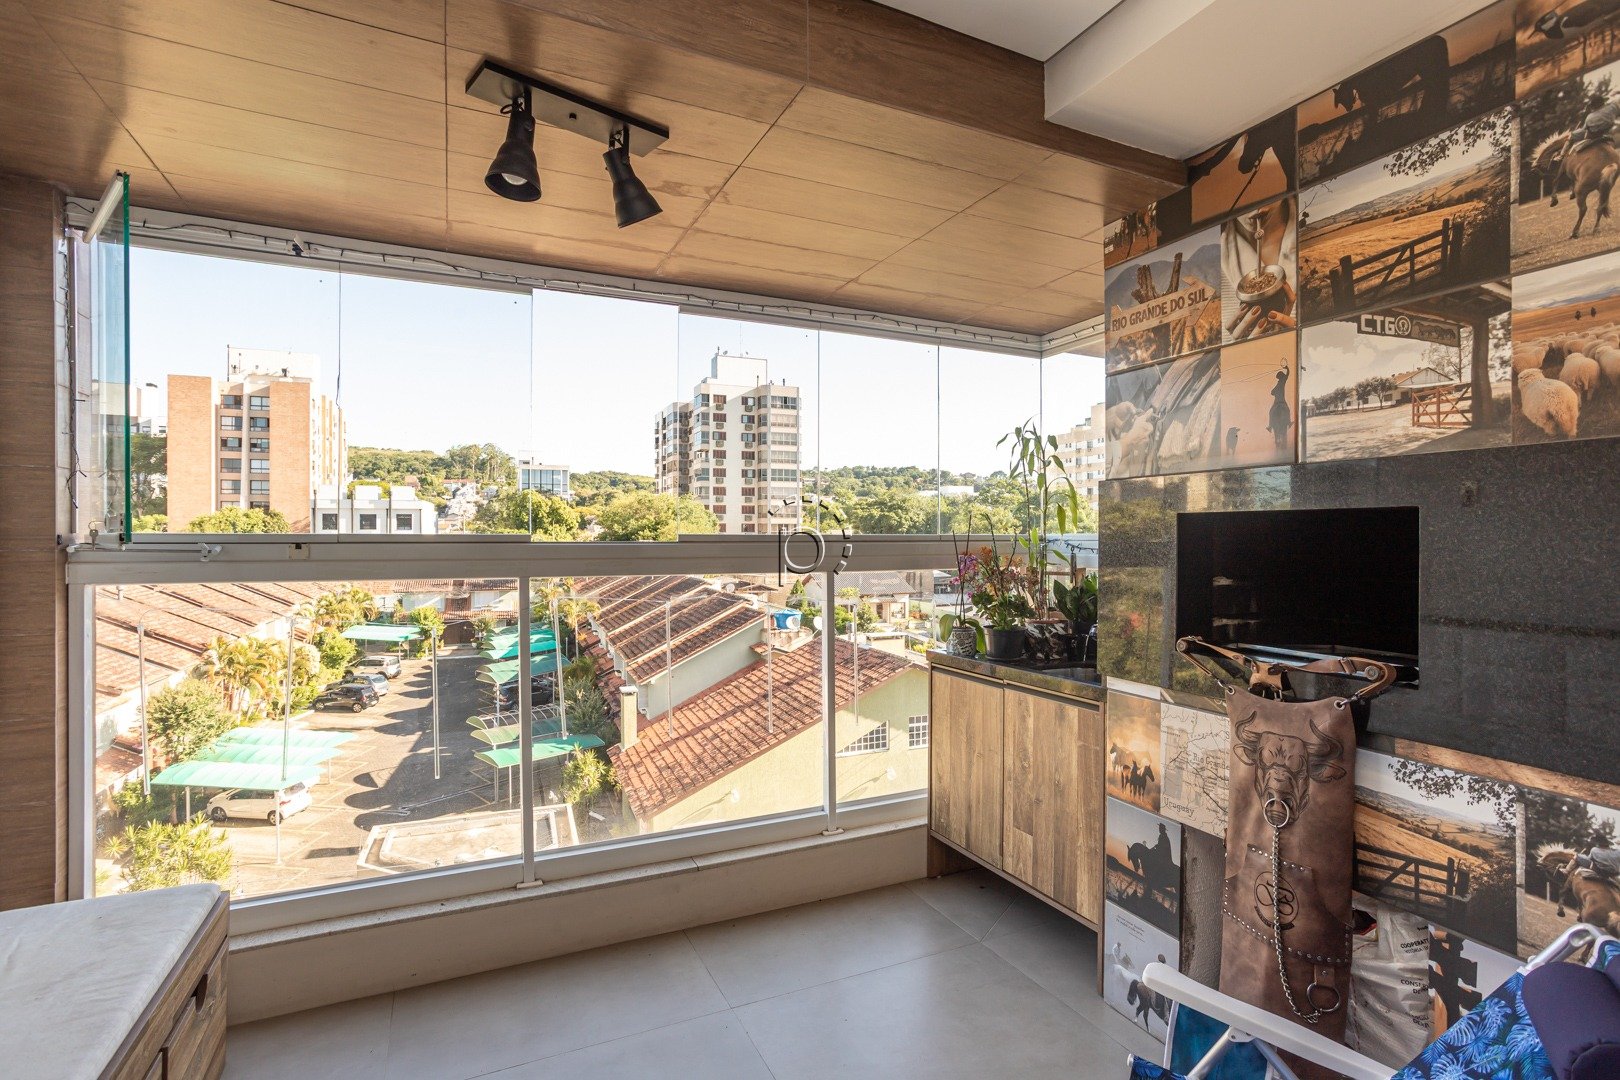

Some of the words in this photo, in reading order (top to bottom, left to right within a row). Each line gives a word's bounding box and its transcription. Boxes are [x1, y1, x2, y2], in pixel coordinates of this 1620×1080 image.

[1112, 316, 1127, 332] RIO
[1129, 301, 1168, 326] GRANDE
[1169, 296, 1186, 312] DO
[1187, 288, 1209, 307] SUL
[1163, 797, 1194, 818] Uruguay
